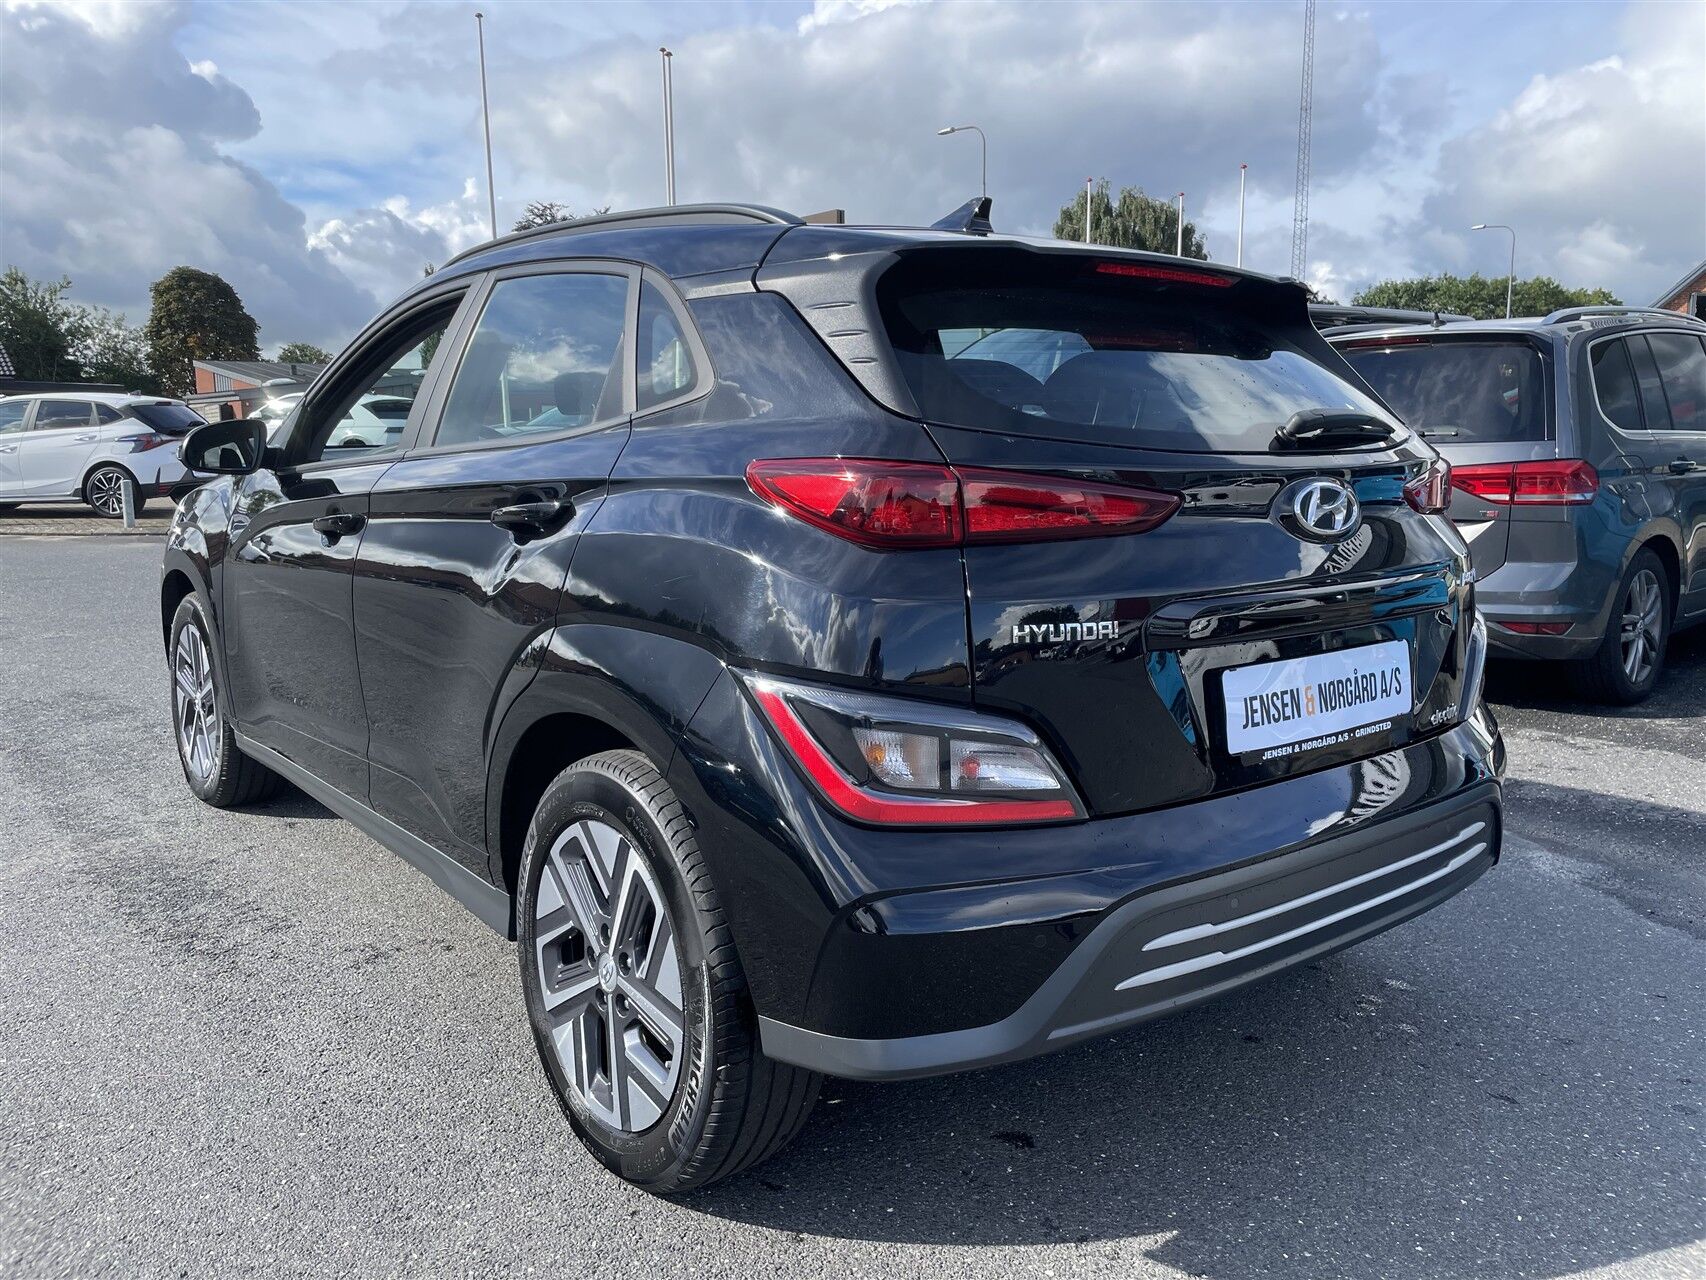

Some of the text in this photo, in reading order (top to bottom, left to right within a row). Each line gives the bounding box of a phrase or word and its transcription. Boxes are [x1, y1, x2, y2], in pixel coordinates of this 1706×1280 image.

[1012, 620, 1119, 644] HYUNDAI
[1242, 666, 1402, 730] JENSEN & NØRGÅRD A/S
[1262, 721, 1392, 761] JENSEN & NØRGÅRD A/S GRINDSTED
[670, 1035, 703, 1147] MICHELIN
